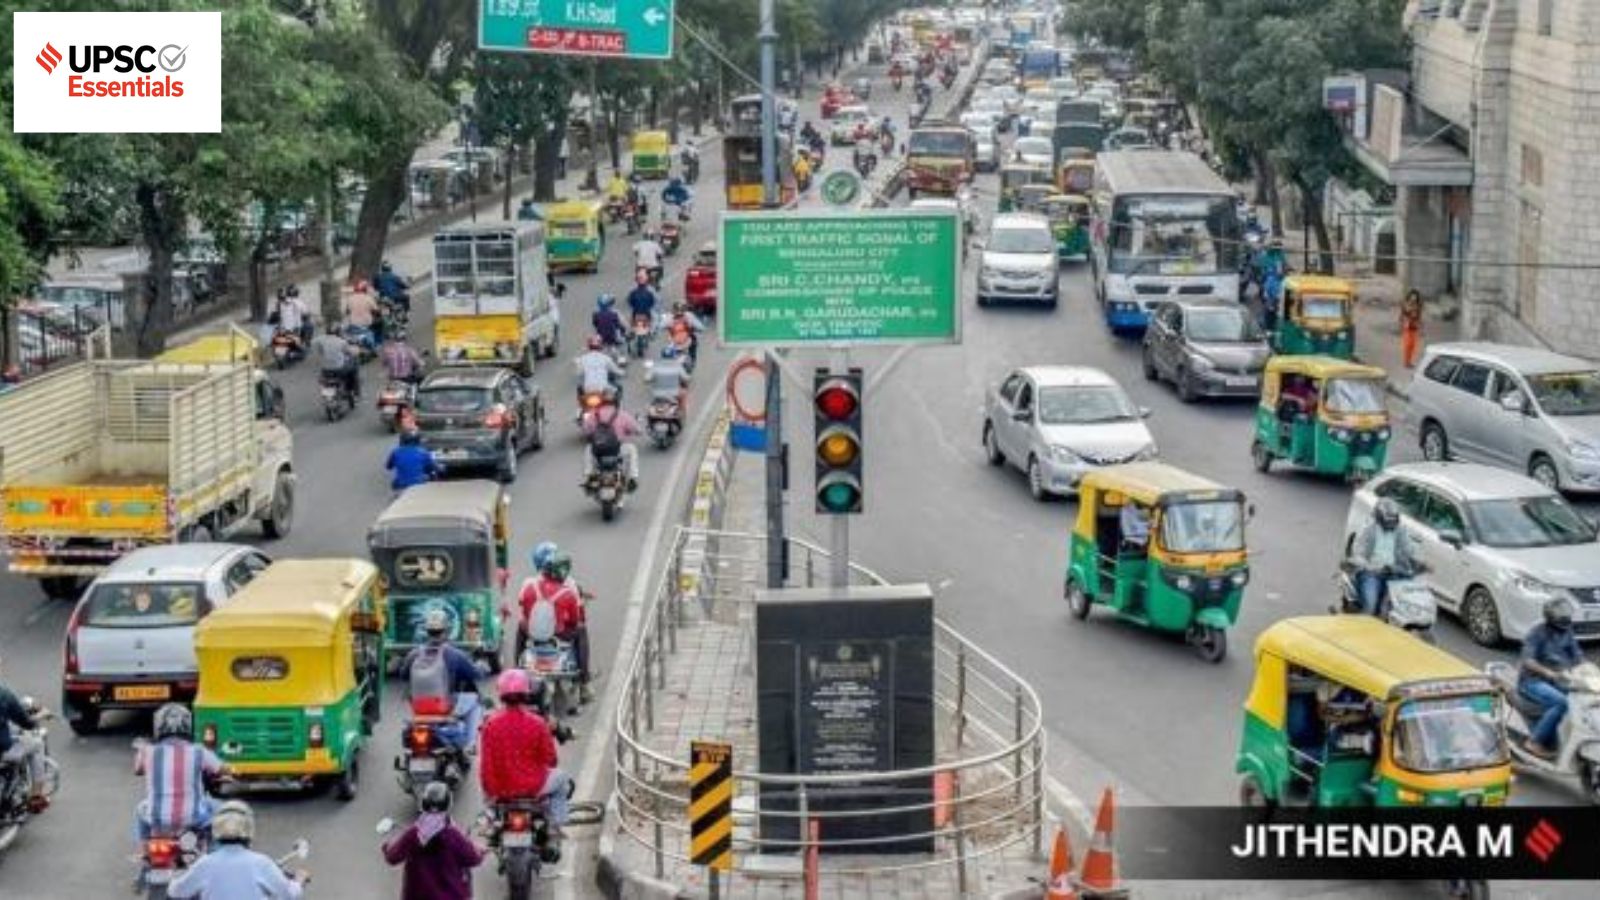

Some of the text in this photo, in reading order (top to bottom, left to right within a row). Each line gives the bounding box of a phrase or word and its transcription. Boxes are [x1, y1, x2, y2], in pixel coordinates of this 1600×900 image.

[740, 231, 939, 246] FIRST TRAFFIC SIGNAL OF
[778, 248, 900, 258] BENGALURU CITY
[759, 275, 788, 288] SRI
[740, 309, 765, 321] SRI
